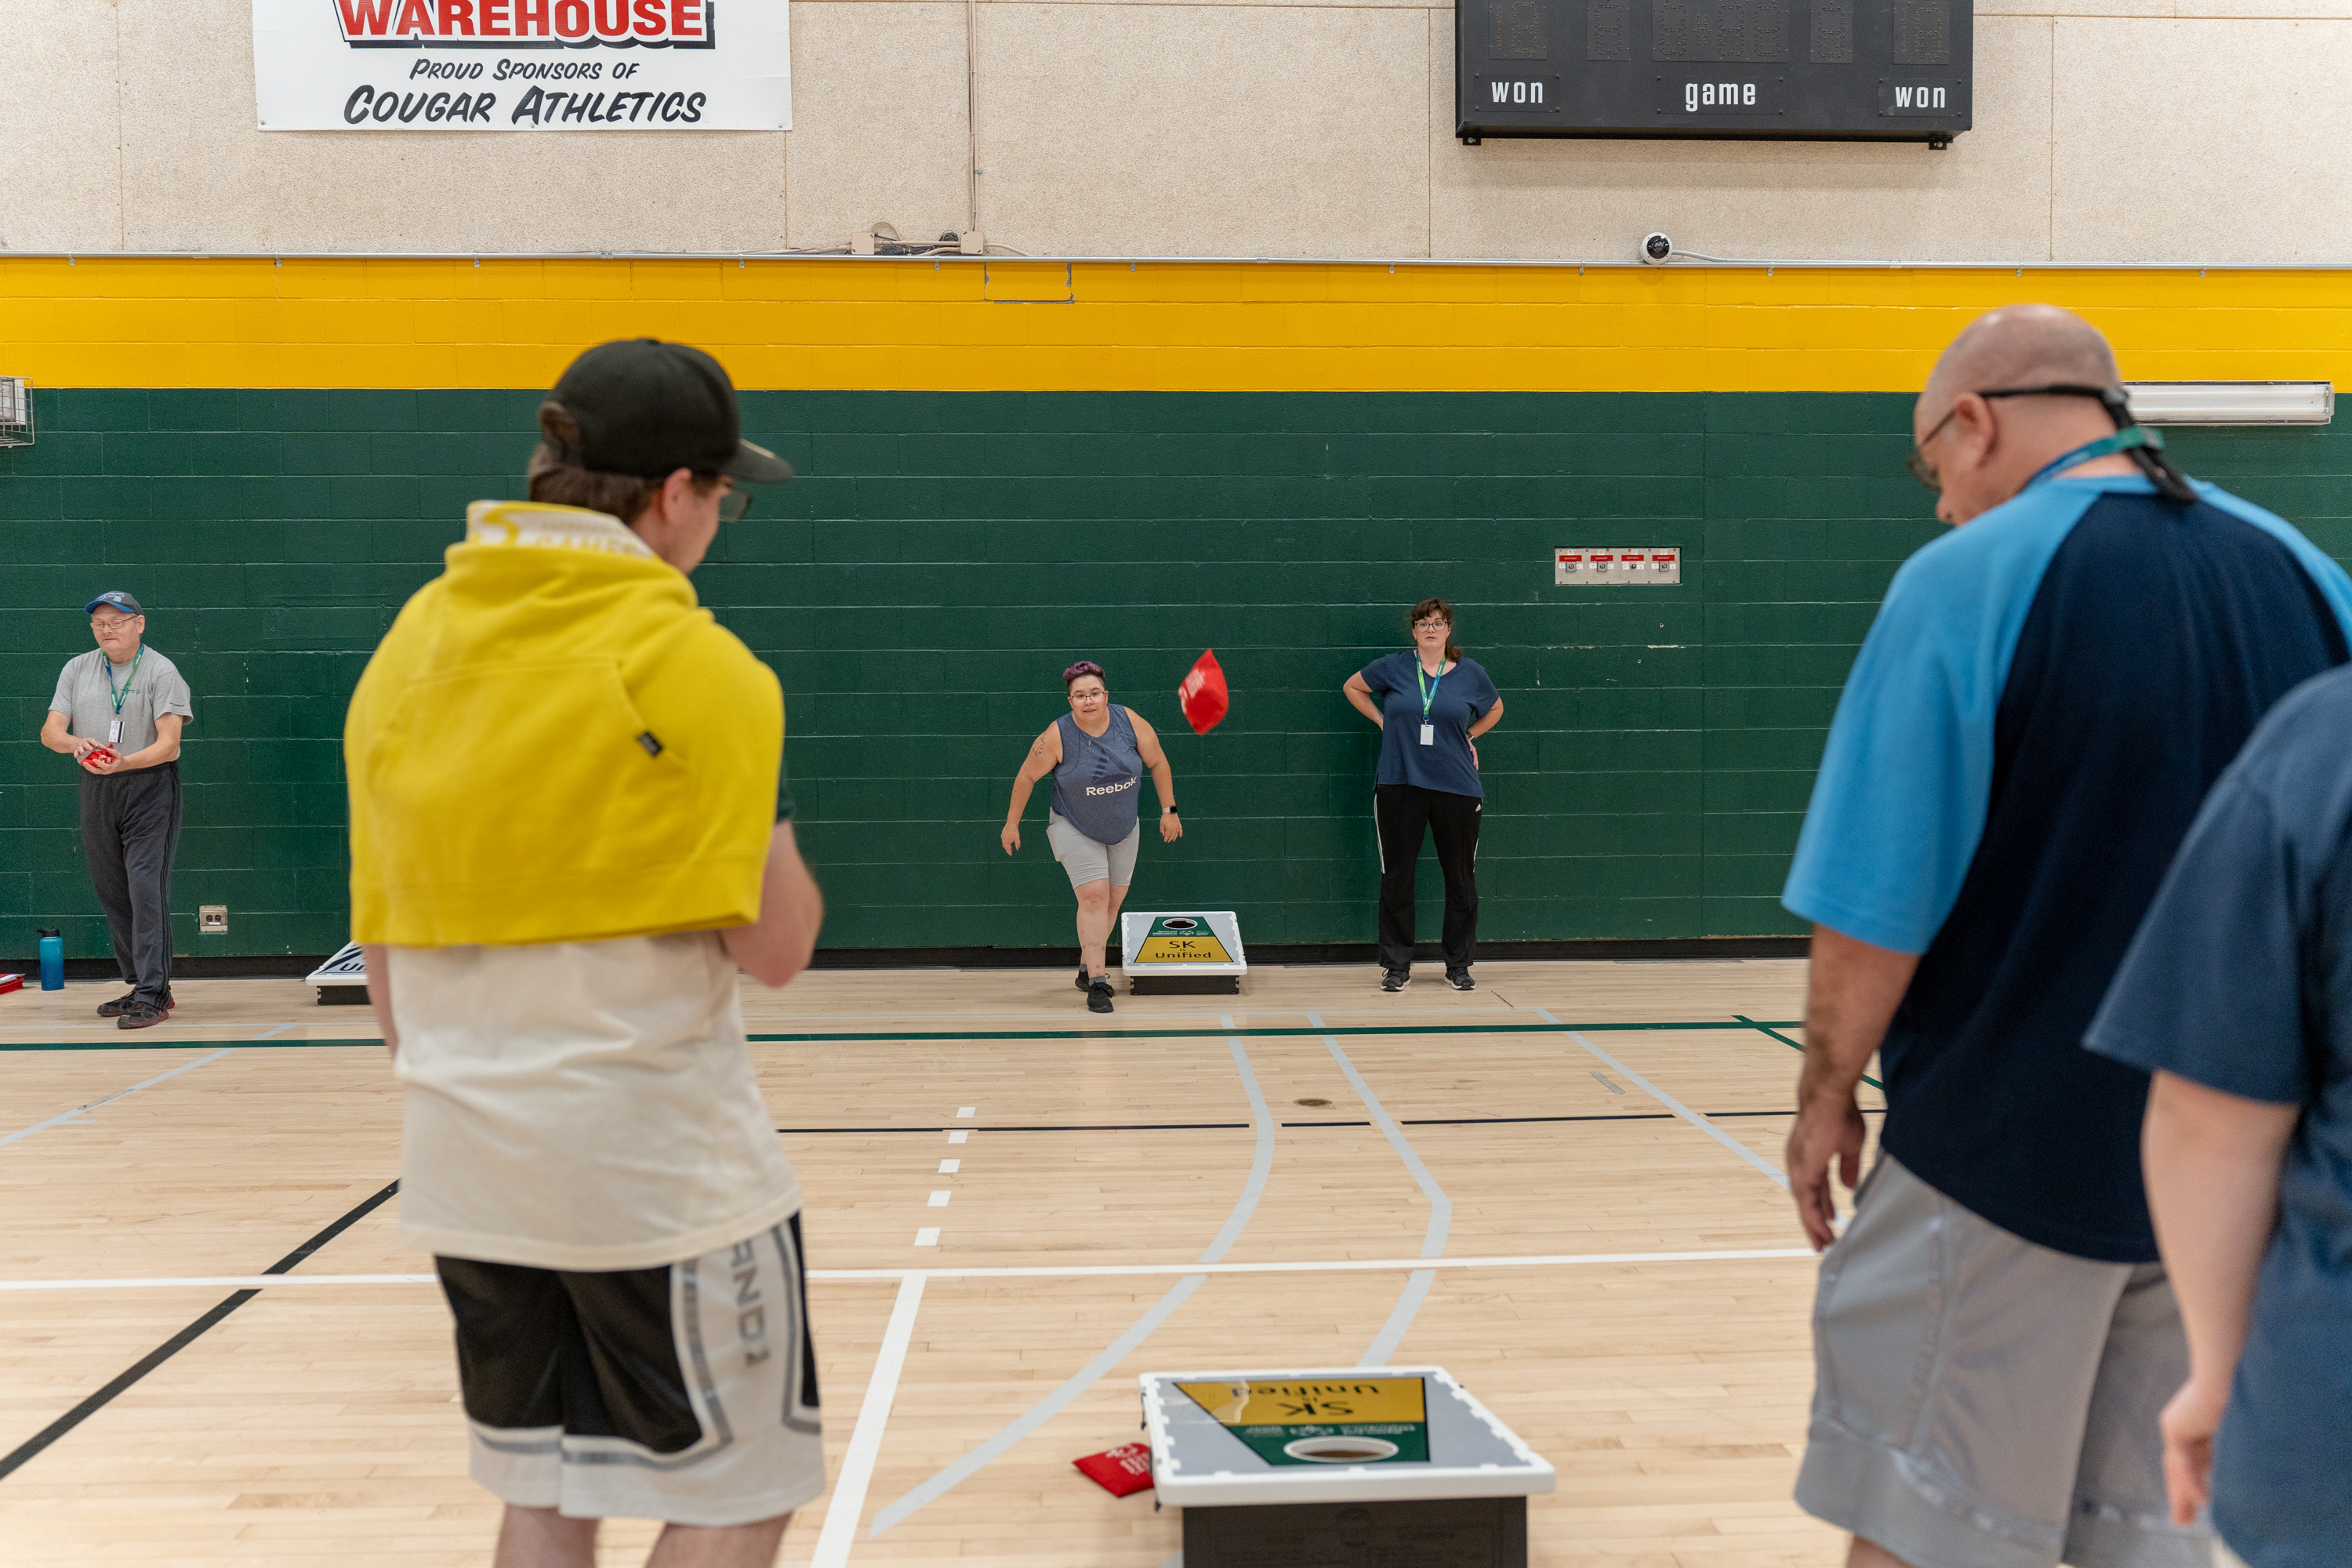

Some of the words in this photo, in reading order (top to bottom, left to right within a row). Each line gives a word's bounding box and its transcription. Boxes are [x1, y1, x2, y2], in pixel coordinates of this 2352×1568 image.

[338, 0, 703, 38] WAREHOUSE
[409, 58, 483, 80] PROUD
[492, 58, 602, 81] SPONSORS
[612, 62, 641, 80] OF
[1491, 82, 1544, 103] won
[1686, 82, 1756, 112] game
[1895, 86, 1946, 108] won
[343, 84, 496, 125] COUGAR
[511, 85, 706, 125] ATHLETICS
[1086, 776, 1137, 797] Reebok
[1231, 1385, 1380, 1398] Unified
[1277, 1401, 1355, 1417] SK
